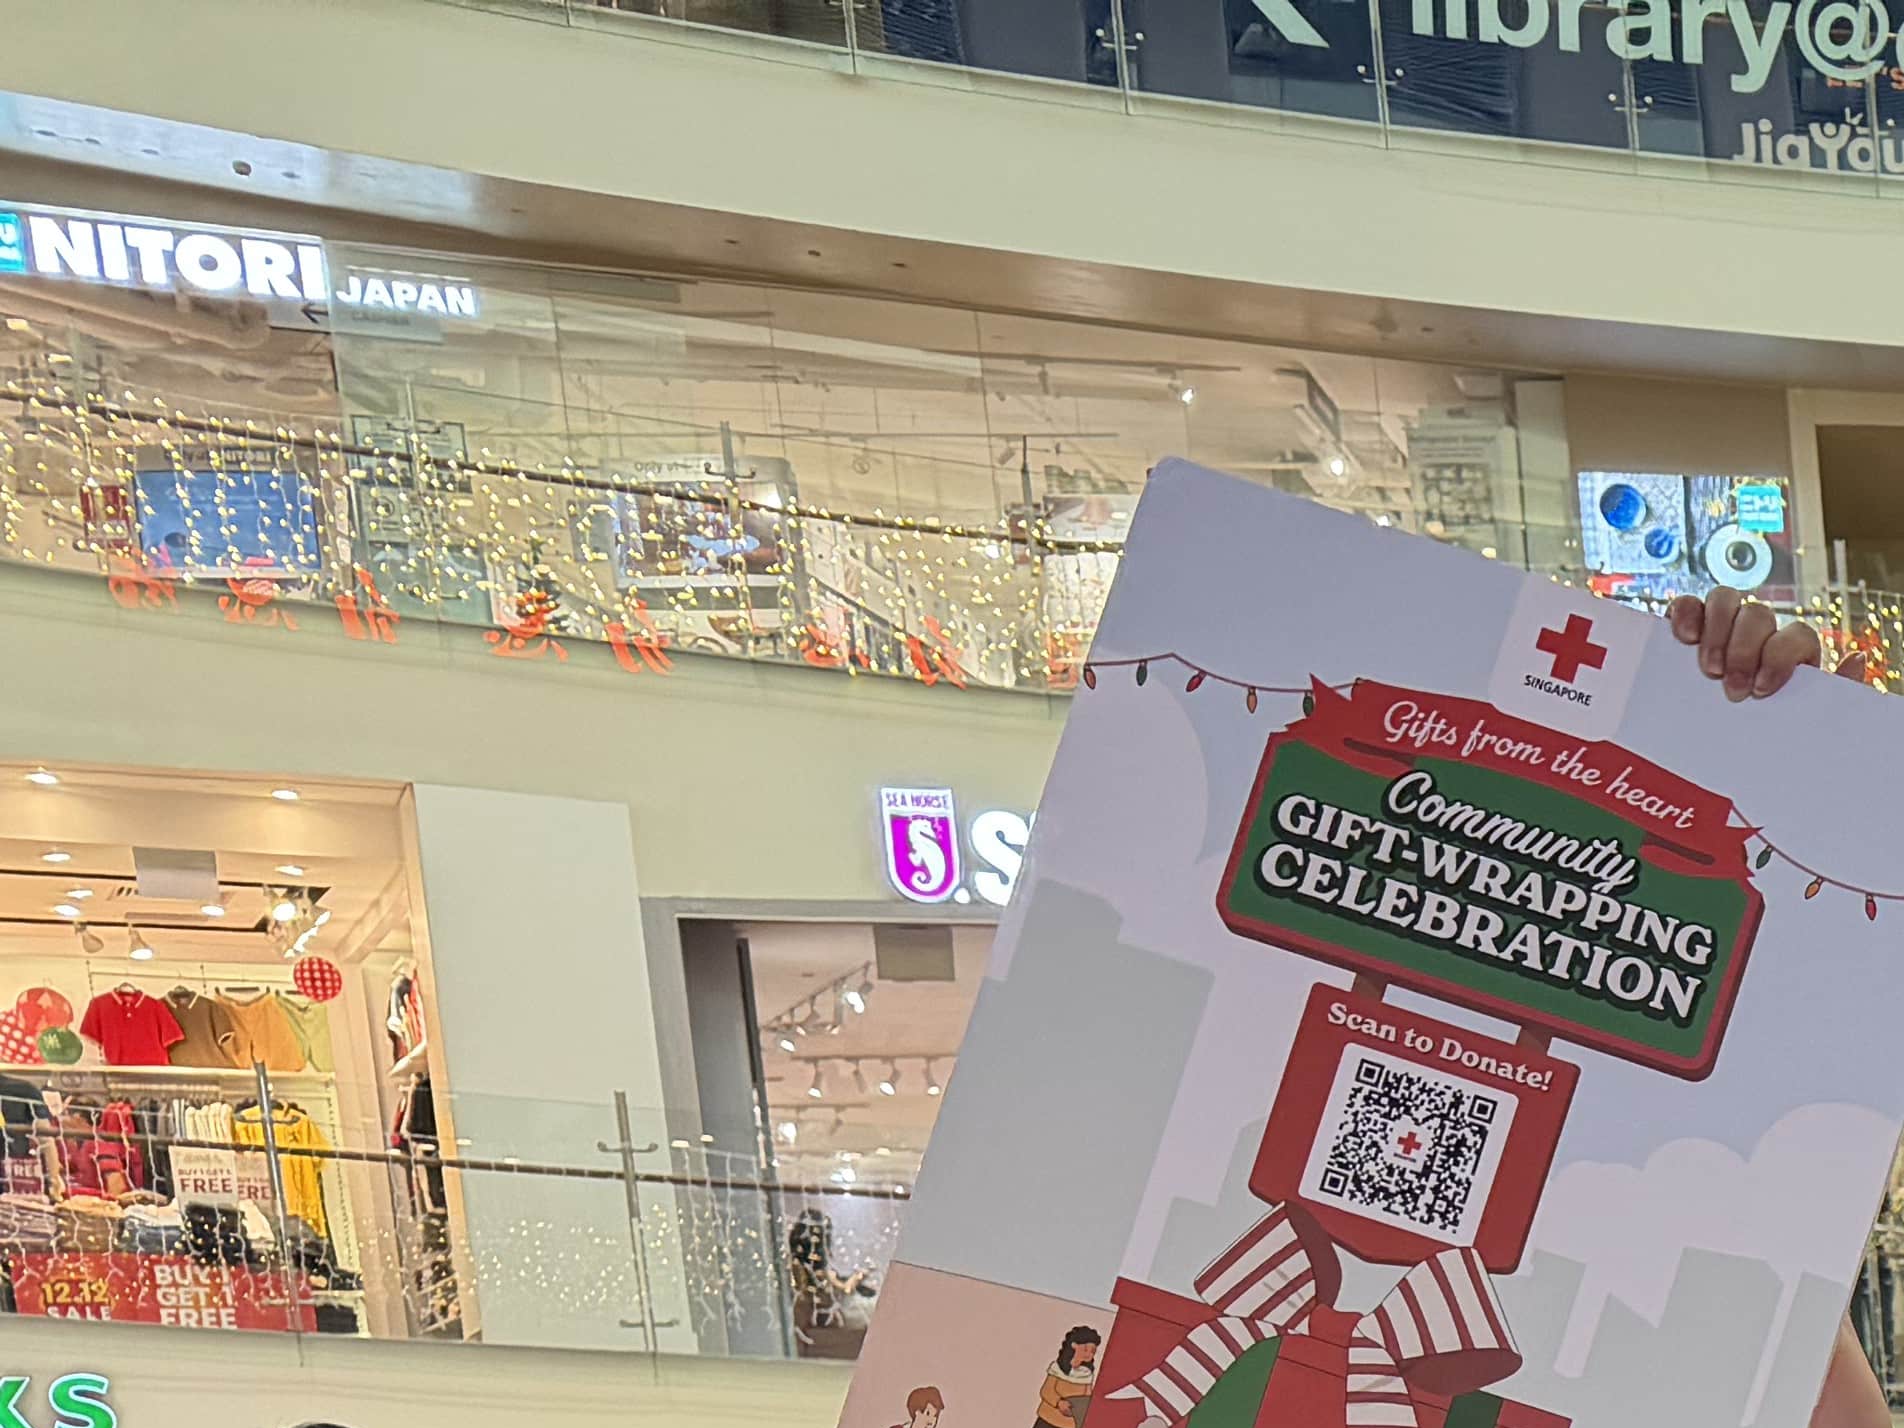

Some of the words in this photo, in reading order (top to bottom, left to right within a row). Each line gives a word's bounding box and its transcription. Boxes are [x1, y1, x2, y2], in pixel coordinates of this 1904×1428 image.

[28, 214, 326, 300] NITORI
[336, 277, 475, 317] JAPAN
[1523, 673, 1594, 707] SINGAPORE
[1383, 699, 1459, 746] Gifts
[1461, 719, 1545, 767] from
[1549, 748, 1602, 787] the
[1604, 773, 1697, 830] heart
[1388, 771, 1637, 892] Community
[1277, 794, 1715, 967] GIFT-WRAPPING
[1260, 843, 1704, 1020] CELEBRATION
[1327, 1001, 1398, 1047] Scan
[1402, 1027, 1435, 1053] to
[1438, 1033, 1554, 1092] Donate!
[181, 1177, 233, 1194] FREE
[41, 1278, 110, 1305] 12.12
[154, 1264, 207, 1286] BUY
[46, 1304, 112, 1321] SALE
[156, 1286, 206, 1306] GET
[160, 1306, 239, 1330] FREE
